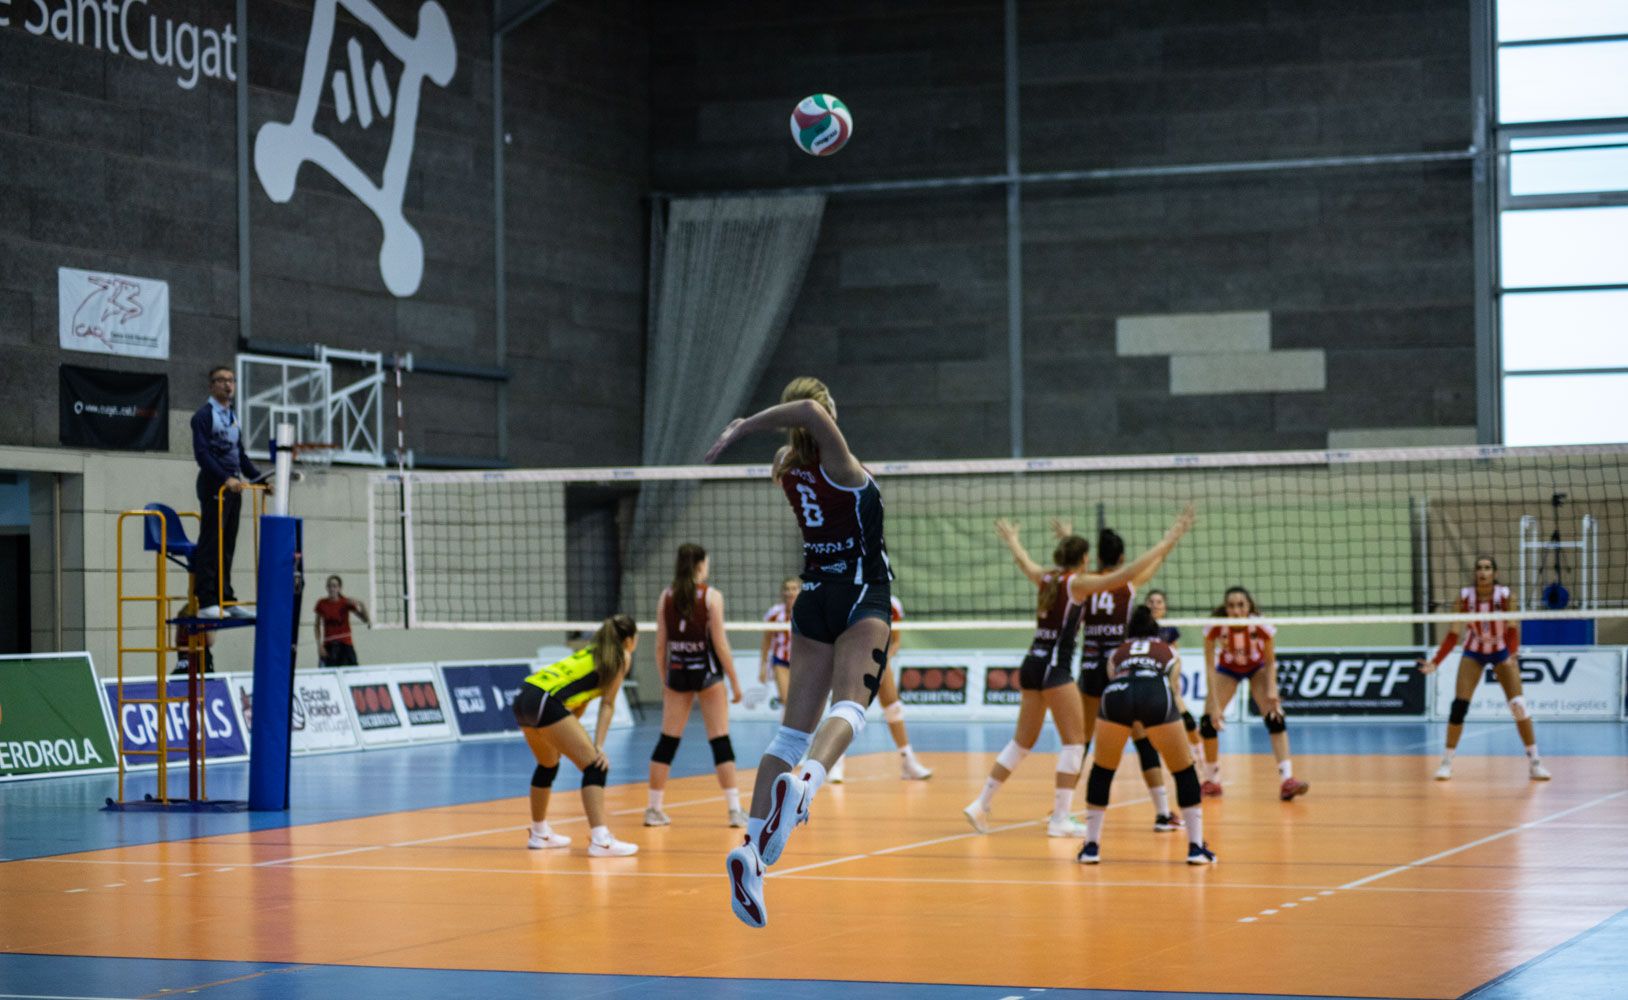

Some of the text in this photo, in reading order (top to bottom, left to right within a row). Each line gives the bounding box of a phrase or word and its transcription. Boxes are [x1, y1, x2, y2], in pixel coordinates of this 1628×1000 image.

[796, 483, 824, 527] 6
[1091, 591, 1114, 616] 14
[1299, 659, 1417, 698] GEFF
